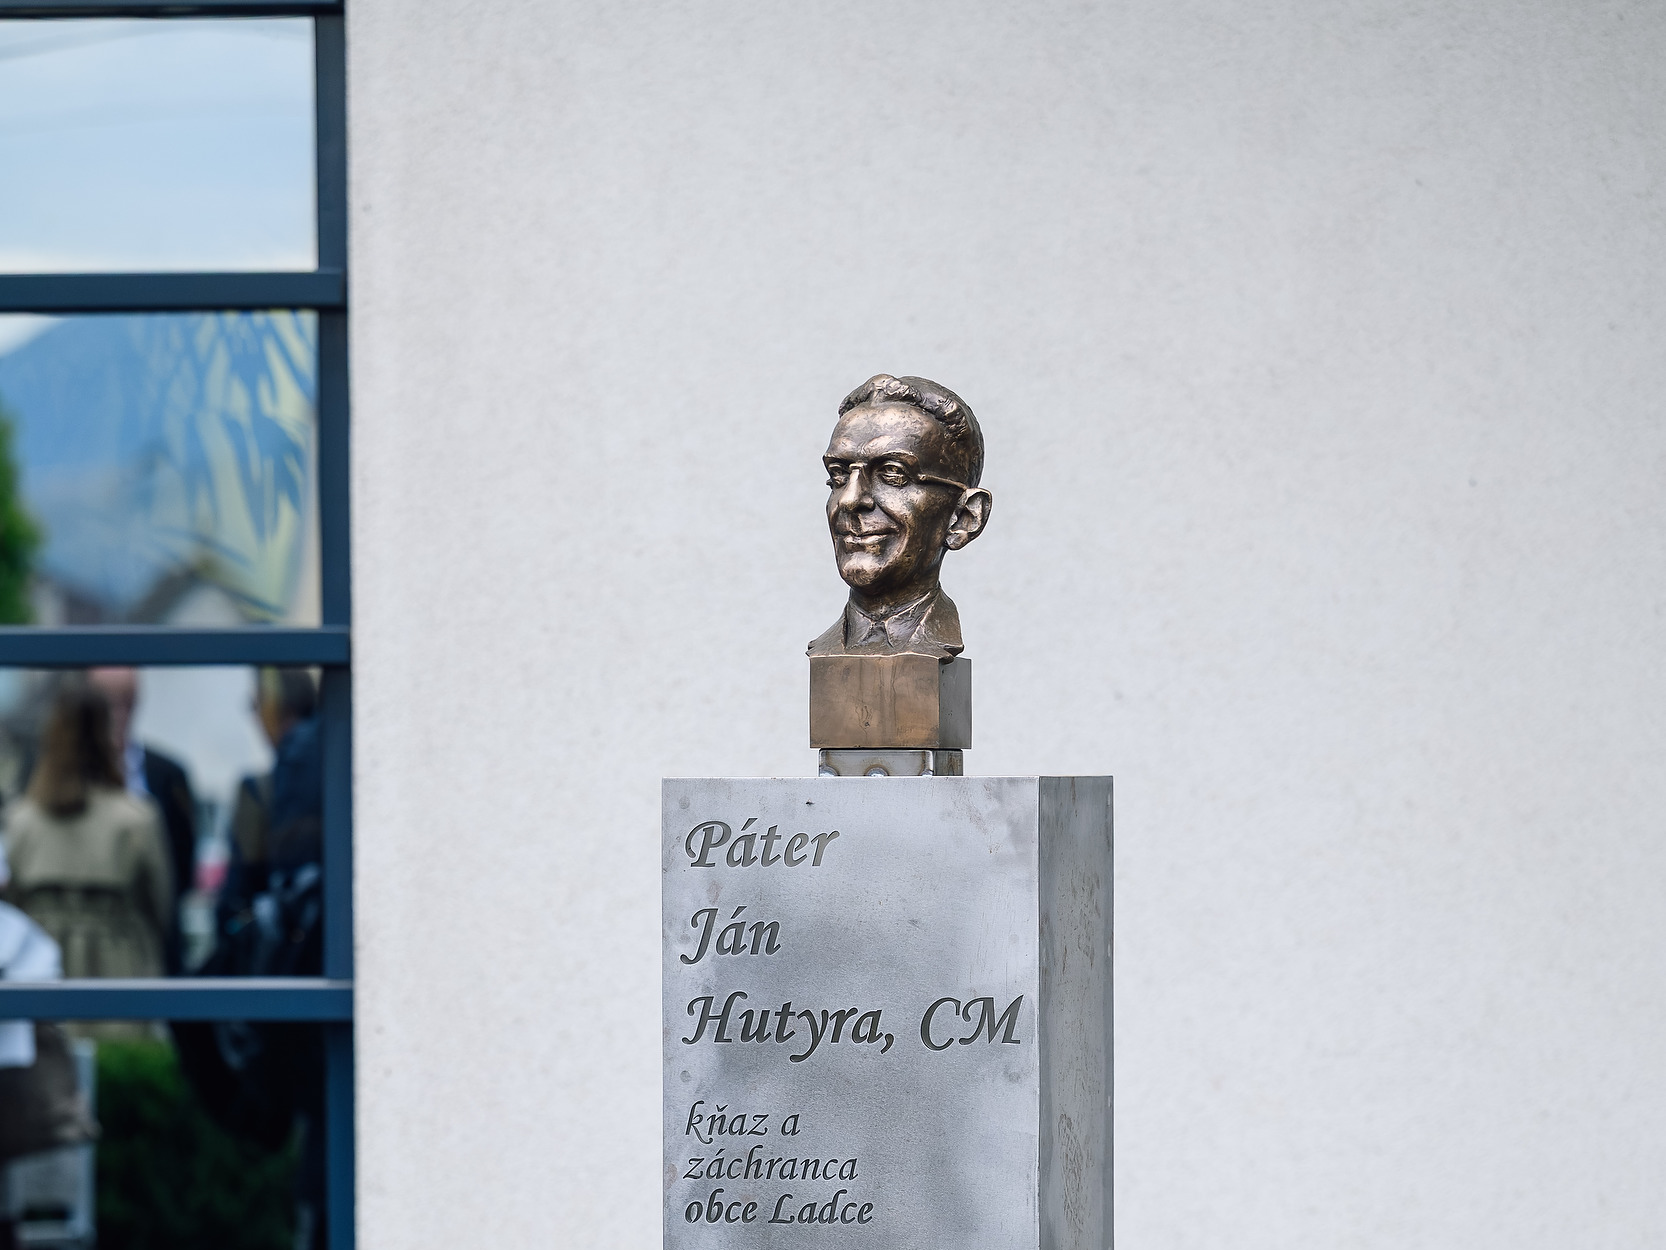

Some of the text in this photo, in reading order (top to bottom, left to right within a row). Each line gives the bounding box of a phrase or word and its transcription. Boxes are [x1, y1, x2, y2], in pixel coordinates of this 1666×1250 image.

[683, 818, 840, 868] Páter
[679, 906, 782, 965] Ján
[681, 991, 1025, 1063] Hutyra, CM
[685, 1100, 801, 1144] kňaz a
[683, 1144, 859, 1181] záchranca
[684, 1188, 874, 1225] obce Ladce
